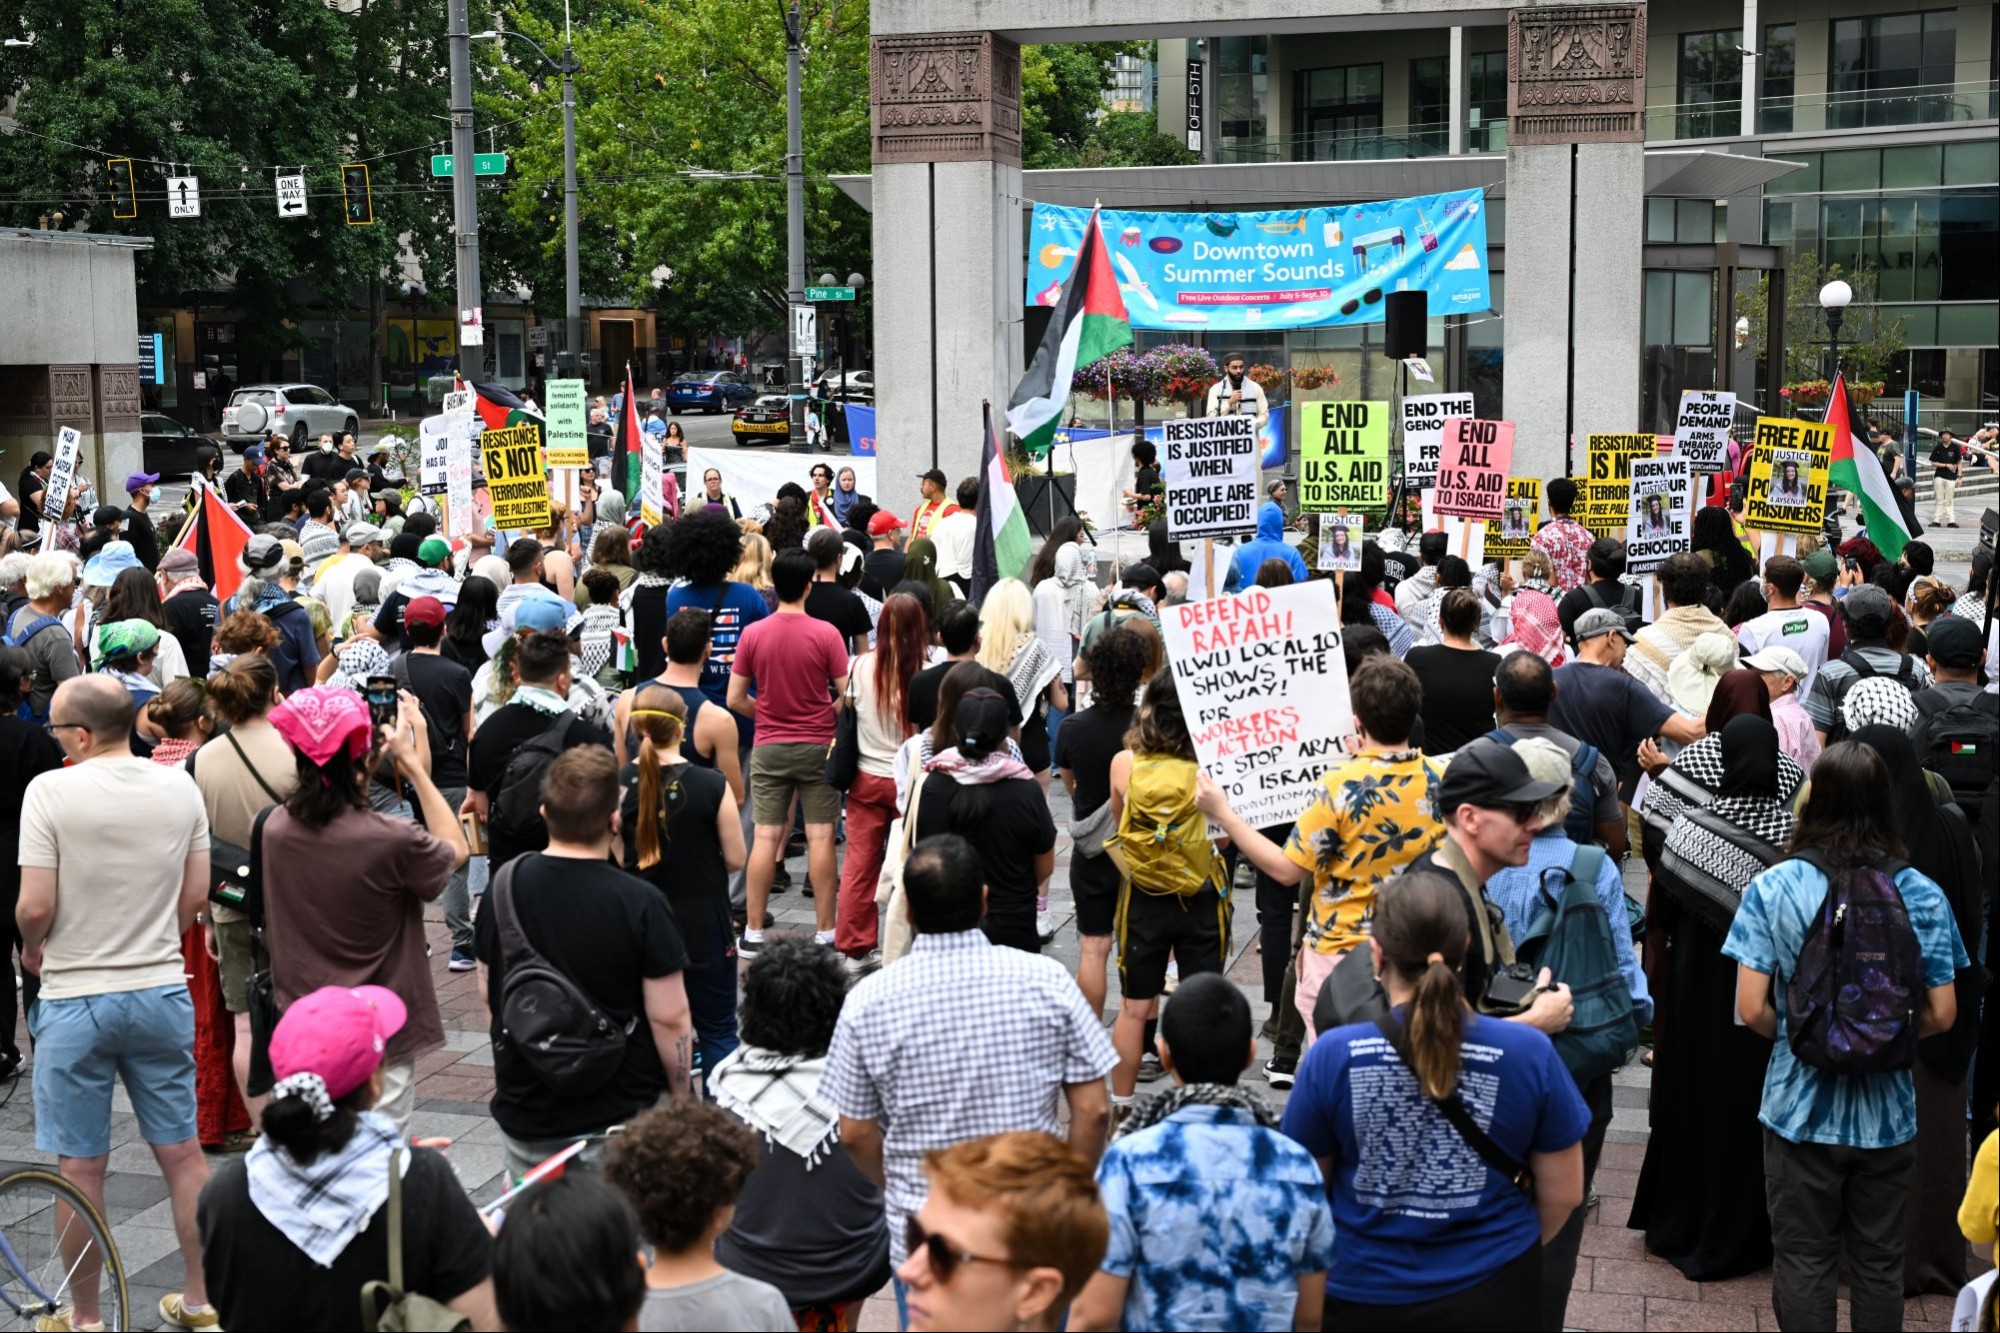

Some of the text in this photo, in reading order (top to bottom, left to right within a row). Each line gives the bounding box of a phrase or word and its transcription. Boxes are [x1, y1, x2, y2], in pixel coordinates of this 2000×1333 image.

[1188, 63, 1200, 94] 5TH
[1188, 97, 1200, 128] OFF
[482, 162, 490, 170] St
[281, 179, 300, 189] ONE
[282, 190, 300, 200] WAY
[174, 206, 194, 214] ONLY
[1194, 242, 1314, 260] Downtown
[1164, 258, 1344, 283] Summer Sounds
[810, 289, 827, 298] Pine
[1280, 292, 1293, 301] July
[1452, 292, 1481, 301] amazon
[530, 332, 545, 340] MUST
[1702, 393, 1716, 401] THE
[1322, 404, 1368, 428] END
[1405, 400, 1472, 417] END THE
[1686, 403, 1731, 415] PEOPLE
[1167, 419, 1252, 441] RESISTANCE
[1679, 416, 1731, 428] DEMAND
[484, 428, 537, 449] RESISTANCE
[548, 430, 584, 439] Palestine
[1458, 422, 1497, 444] END
[1690, 432, 1714, 440] ARMS
[1757, 424, 1830, 452] FREE ALL
[1168, 438, 1252, 460] IS JUSTIFIED
[1324, 430, 1365, 455] ALL
[1590, 436, 1654, 451] RESISTANCE
[1679, 441, 1722, 450] EMBARGO
[426, 458, 438, 468] HAS
[486, 450, 503, 479] IS
[506, 446, 538, 478] NOT
[1458, 445, 1491, 467] ALL
[1682, 449, 1718, 460] NOW!
[1775, 450, 1809, 461] JUSTICE
[1189, 458, 1232, 477] WHEN
[1306, 461, 1382, 482] U.S. AID
[1591, 453, 1609, 479] IS
[1634, 463, 1665, 478] BIDEN,
[1667, 462, 1687, 475] WE
[1440, 470, 1470, 490] U.S.
[1474, 472, 1503, 493] AID
[1642, 483, 1668, 495] JUSTICE
[490, 481, 546, 501] TERRORISM!
[1169, 483, 1254, 507] PEOPLE ARE
[1304, 485, 1382, 500] TO ISRAEL!
[1518, 482, 1538, 499] ALL
[1589, 485, 1629, 500] TERROR
[1437, 490, 1502, 509] TO ISRAEL!
[1775, 497, 1805, 505] AYSENUR
[495, 501, 548, 517] FREE PALESTINE!
[1174, 504, 1250, 525] OCCUPIED!
[1589, 504, 1609, 515] FREE
[1748, 501, 1821, 523] PRISONERS
[526, 518, 549, 526] Coalition
[1323, 516, 1360, 525] JUSTICE
[1648, 530, 1671, 540] AYSENUR
[1628, 539, 1689, 557] GENOCIDE
[1326, 562, 1359, 570] AYSENUR
[1179, 592, 1271, 629] DEFEND
[1193, 611, 1292, 654] RAFAH!
[1176, 632, 1340, 677] ILWU LOCAL 10
[710, 665, 731, 674] WES
[1193, 654, 1327, 696] SHOWS THE
[1224, 680, 1287, 702] WAY!
[1200, 706, 1230, 724] FOR
[1192, 706, 1300, 745] WORKERS
[1217, 728, 1298, 758] ACTION
[1206, 762, 1224, 779] TO
[1235, 746, 1283, 773] STOP
[1222, 783, 1243, 800] TO
